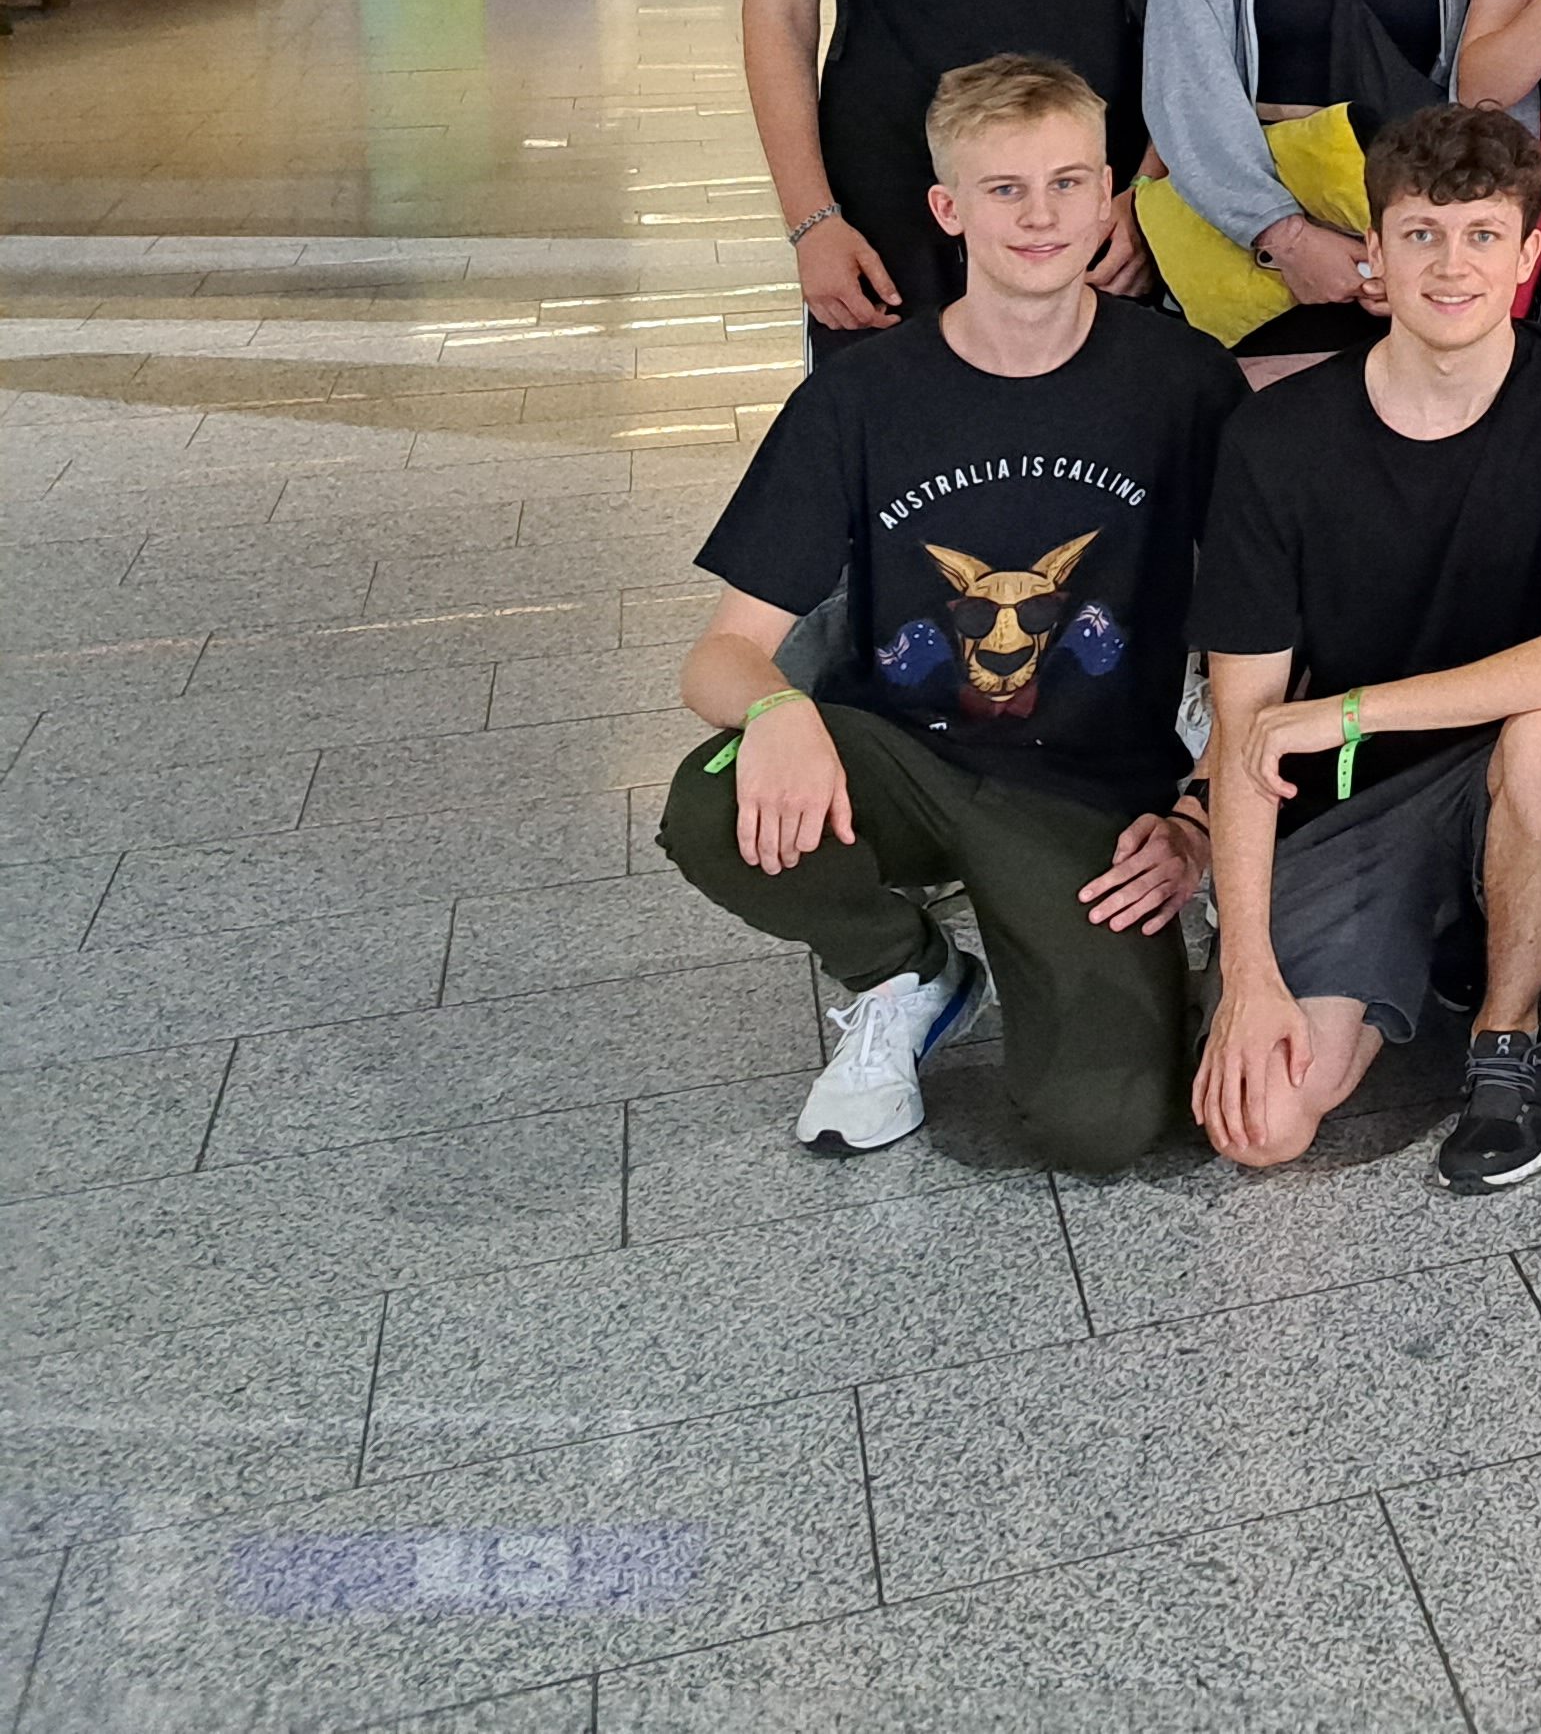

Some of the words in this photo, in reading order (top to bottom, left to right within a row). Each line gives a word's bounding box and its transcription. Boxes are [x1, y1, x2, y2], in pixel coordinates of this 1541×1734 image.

[880, 459, 1009, 529] AUSTRALIA
[1022, 456, 1044, 476] IS
[1054, 458, 1145, 505] CALLING
